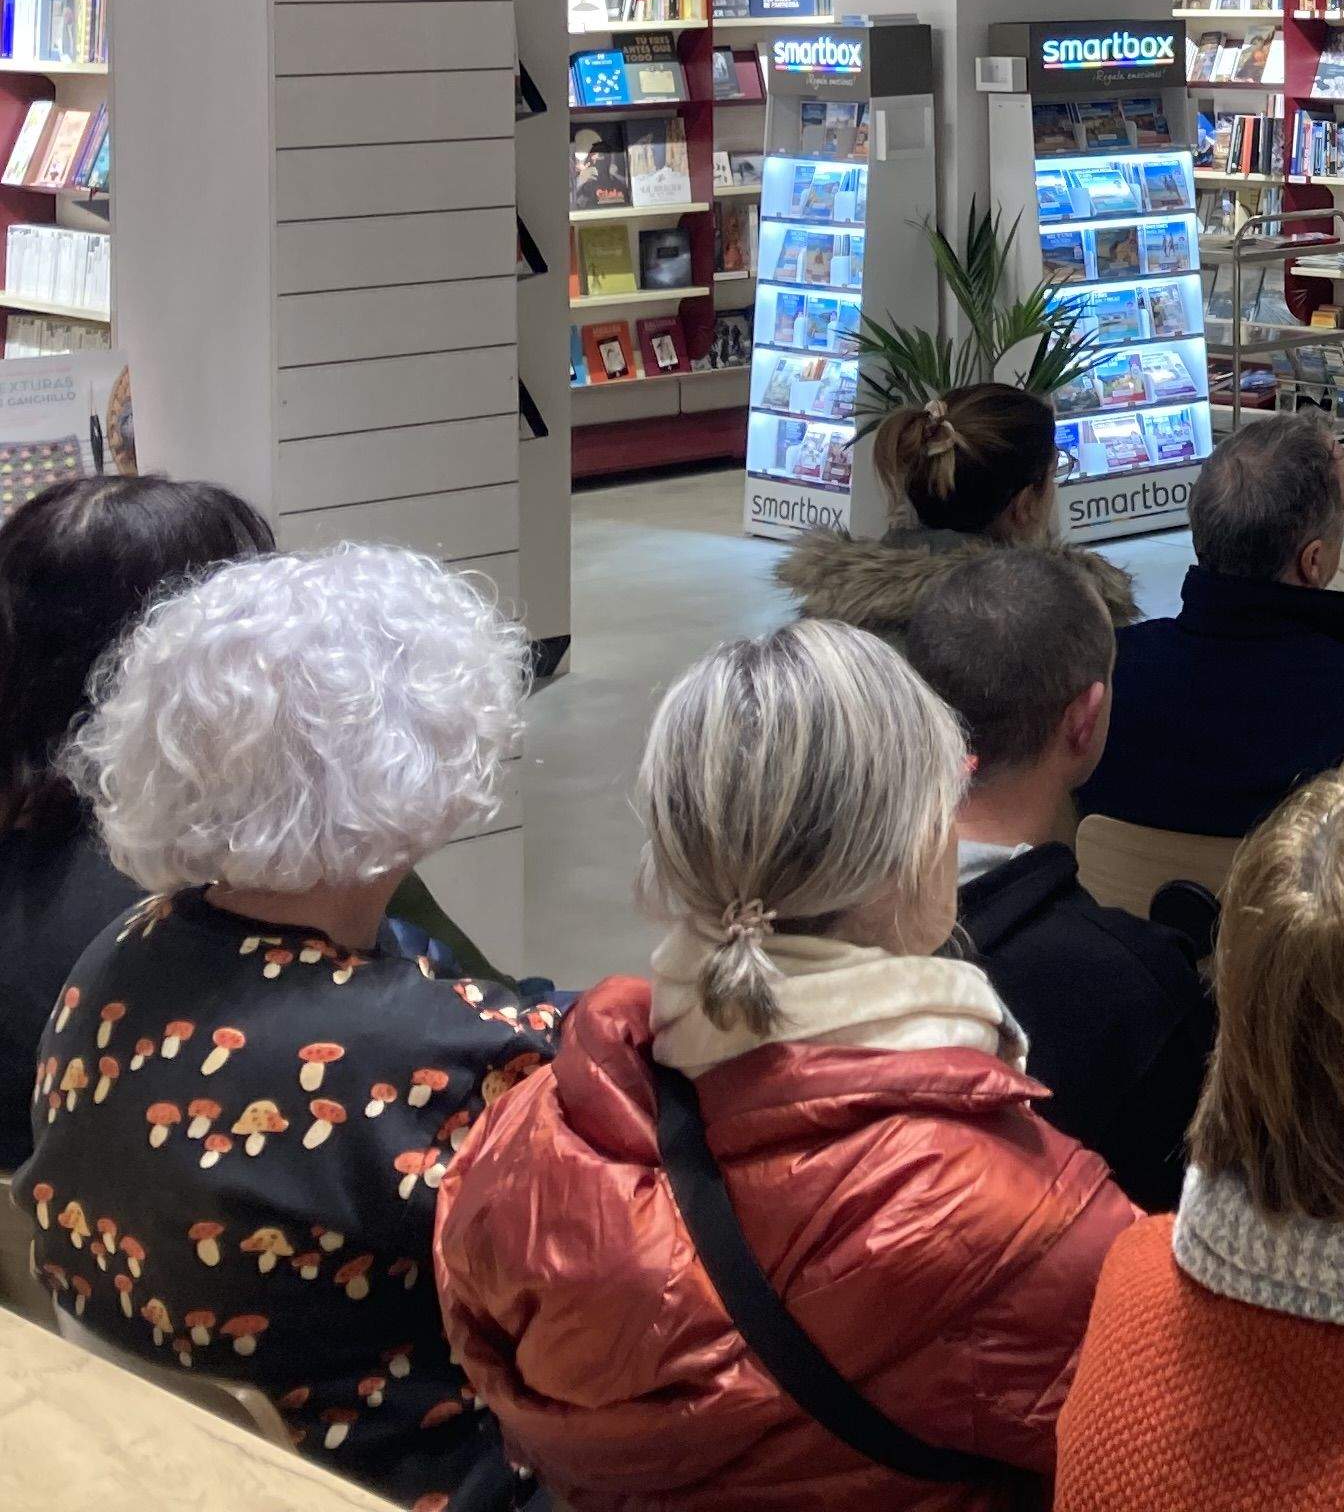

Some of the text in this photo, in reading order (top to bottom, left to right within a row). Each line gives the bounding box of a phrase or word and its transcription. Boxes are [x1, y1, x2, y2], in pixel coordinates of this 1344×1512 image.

[773, 36, 862, 66] smartbox
[1042, 31, 1175, 63] smartbox
[7, 391, 76, 407] GANCHILLO
[752, 494, 843, 529] smartbox
